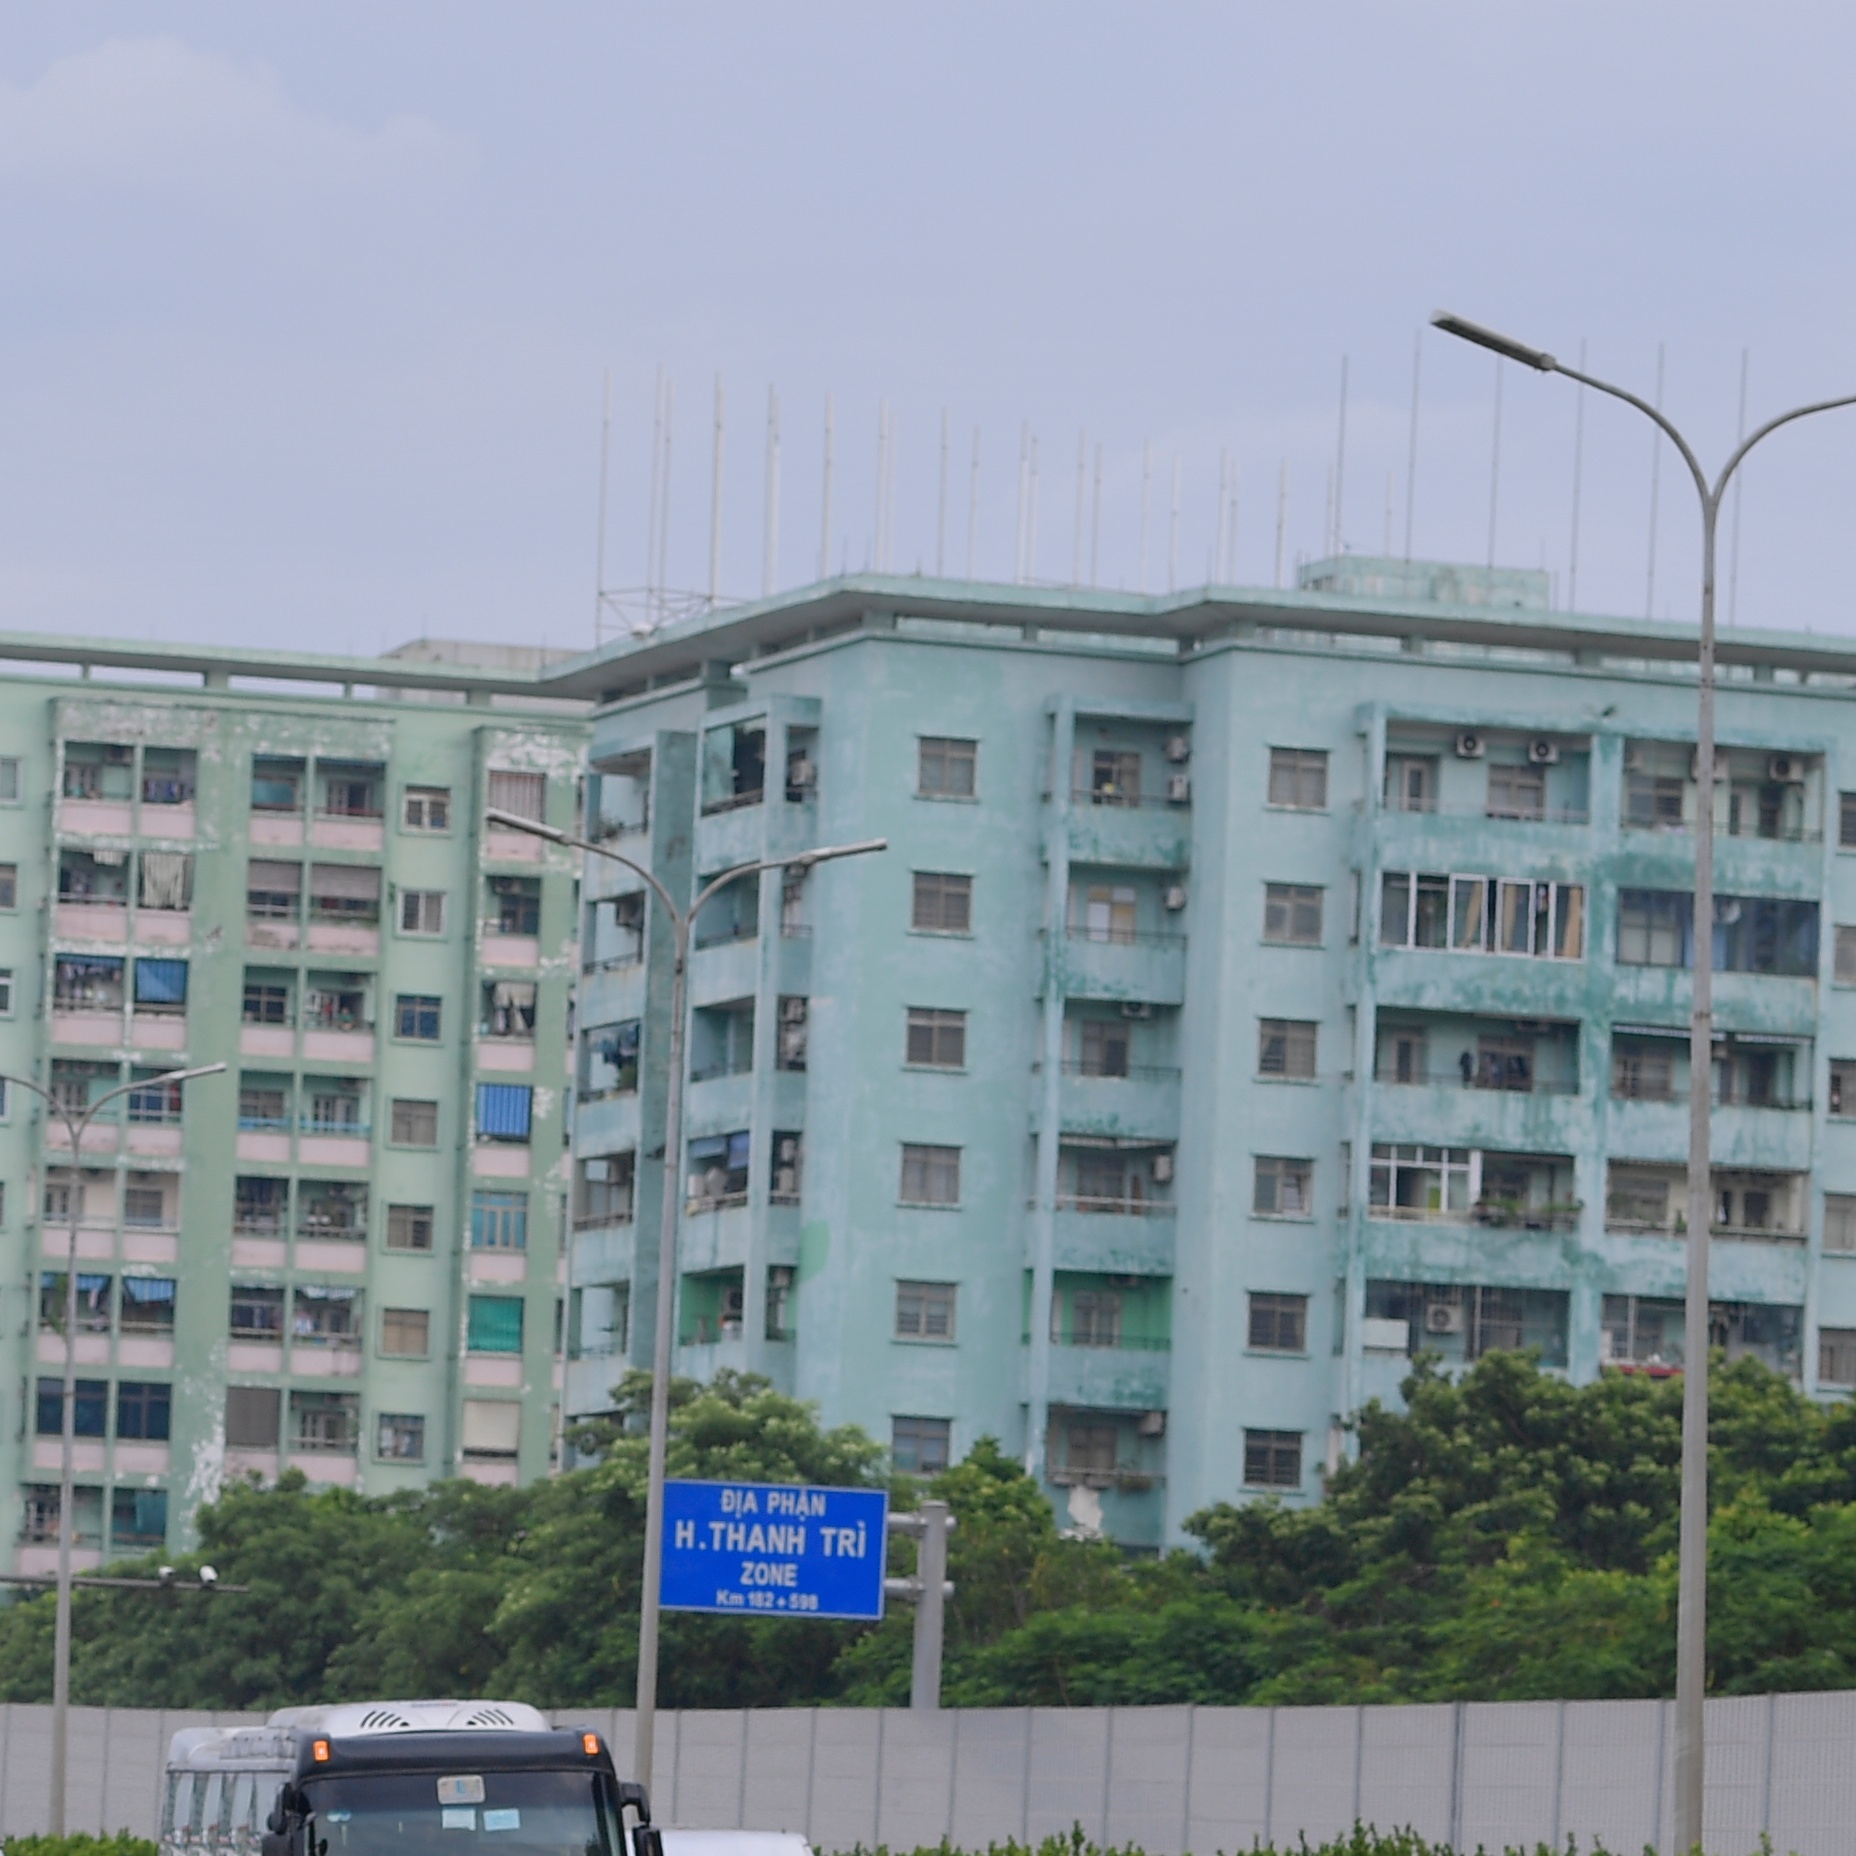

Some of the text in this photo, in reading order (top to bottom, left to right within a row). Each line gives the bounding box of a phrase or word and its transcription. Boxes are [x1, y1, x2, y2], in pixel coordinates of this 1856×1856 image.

[719, 1489, 827, 1522] ĐỊA PHẬN
[819, 1520, 866, 1559] TRÌ
[739, 1560, 798, 1587] ZONE
